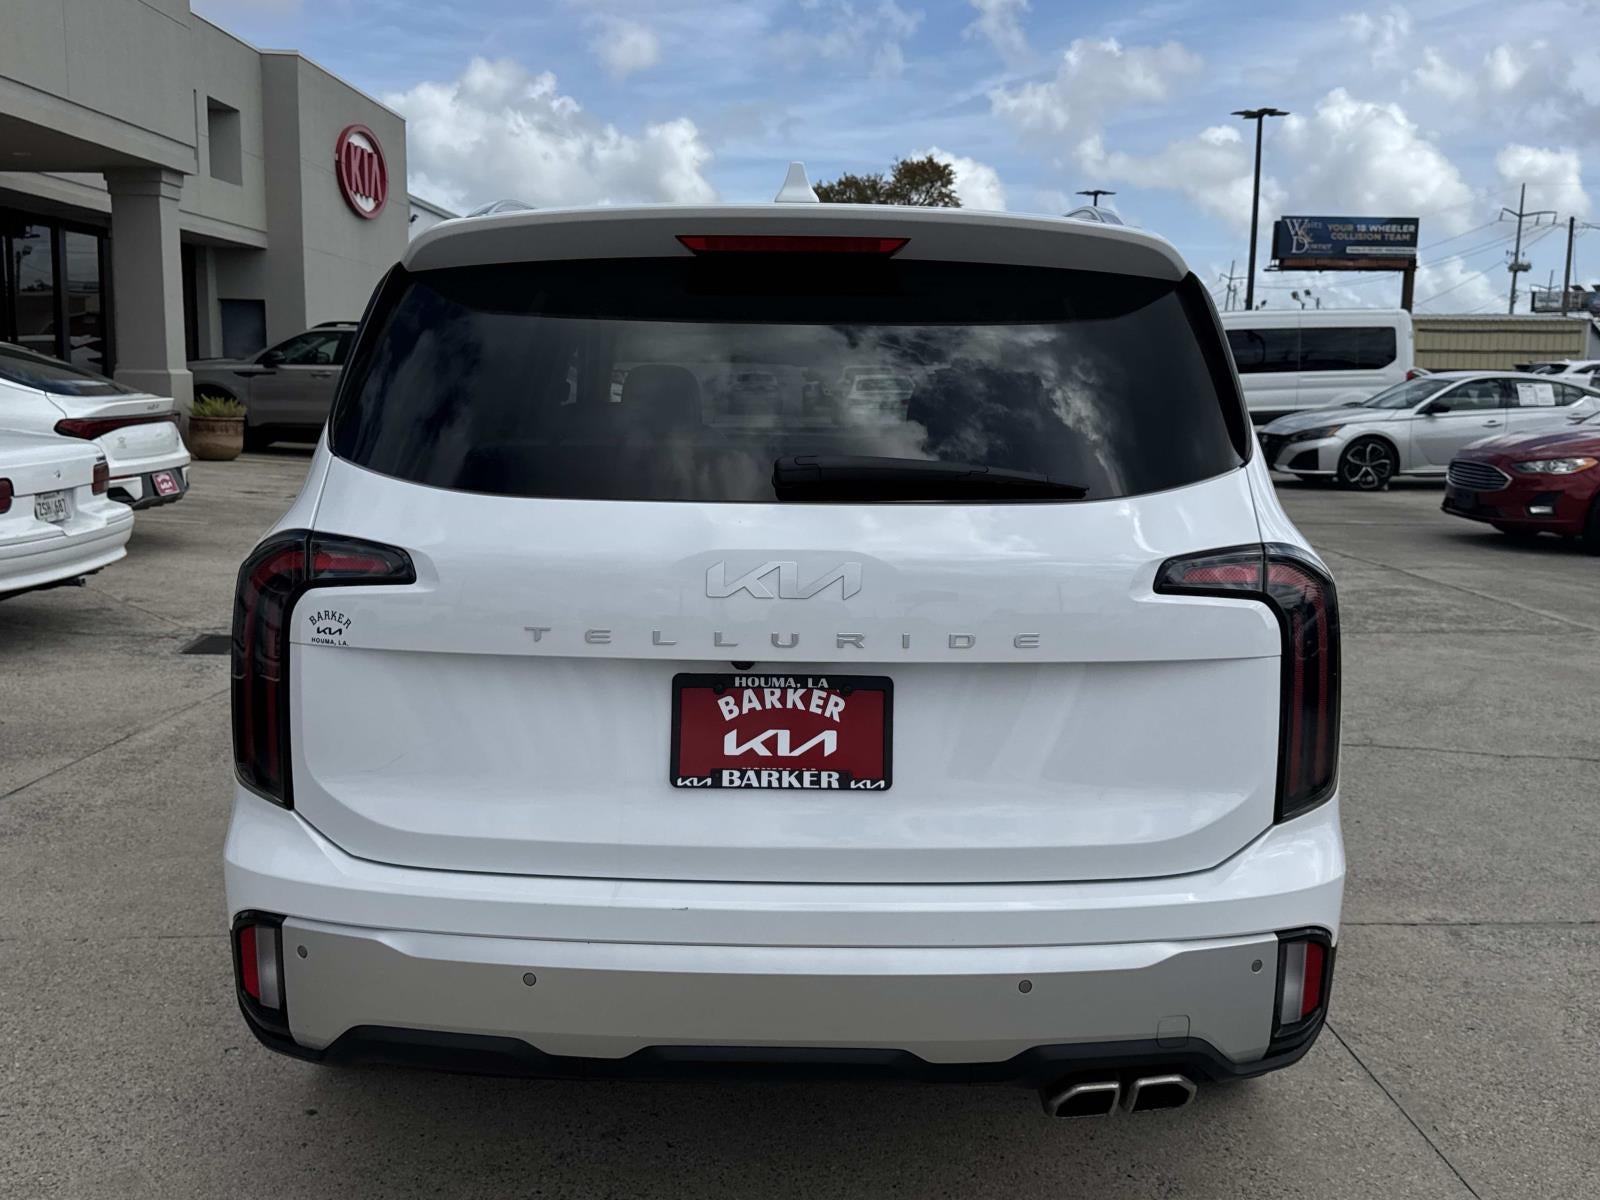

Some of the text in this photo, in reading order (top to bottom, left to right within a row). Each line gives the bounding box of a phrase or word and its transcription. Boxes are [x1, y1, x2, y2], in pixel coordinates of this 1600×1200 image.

[350, 142, 383, 202] KIA
[1327, 223, 1354, 232] YOUR
[1369, 223, 1416, 233] WHEELER
[1330, 232, 1411, 241] COLLISION TEAM
[705, 560, 862, 600] KIA
[309, 611, 352, 629] BARKER
[317, 626, 342, 635] KIA
[524, 626, 1041, 650] TELLURIDE
[311, 637, 336, 646] HOUMA,
[734, 676, 829, 689] HOUMA, LA
[717, 688, 846, 723] BARKER
[723, 728, 838, 758] KIA
[677, 769, 885, 790] KIA BARKER KIA
